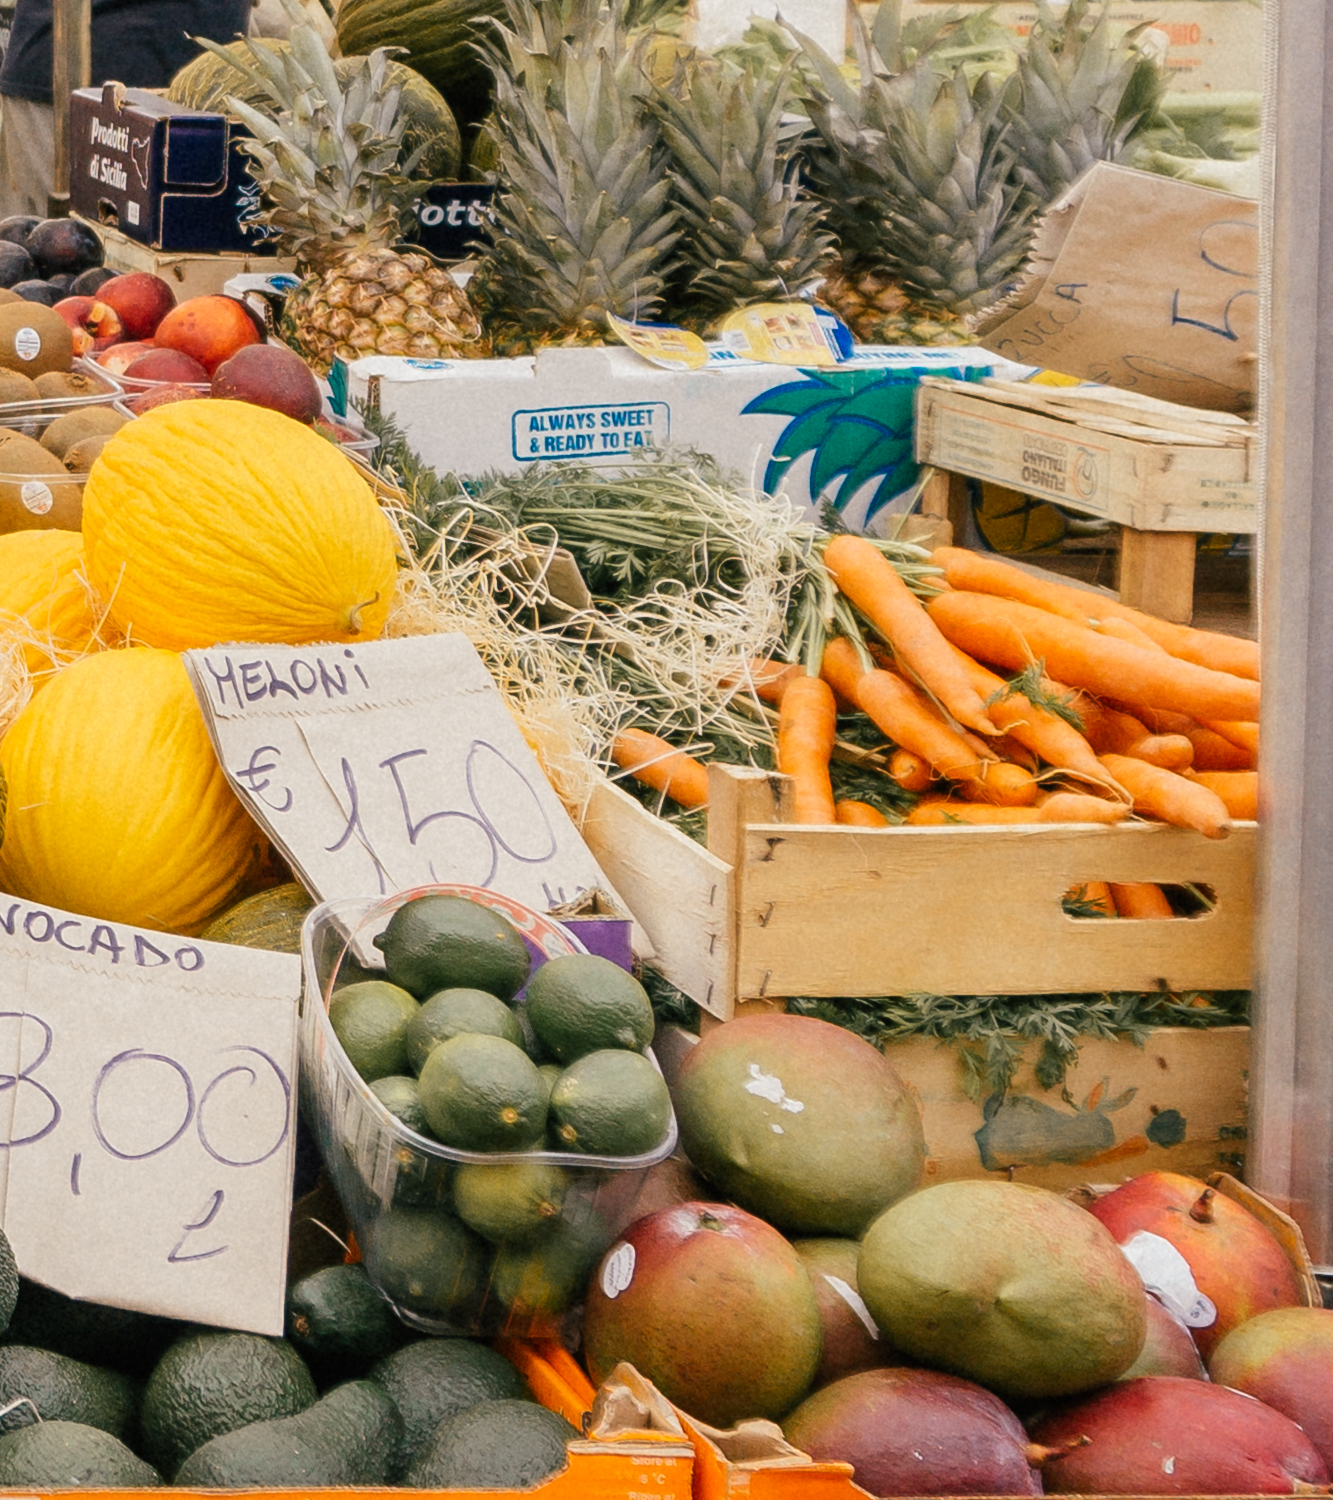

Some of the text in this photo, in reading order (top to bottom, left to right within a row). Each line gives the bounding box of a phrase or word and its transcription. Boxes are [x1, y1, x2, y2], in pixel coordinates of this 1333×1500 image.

[90, 116, 130, 153] Prodotti
[90, 155, 128, 191] di Sicilia
[529, 409, 654, 432] ALWAYS SWEET
[530, 431, 653, 453] & READY TO EAT
[1022, 450, 1068, 473] ITALIANO
[1021, 466, 1066, 492] FUNGO
[236, 745, 293, 812] €
